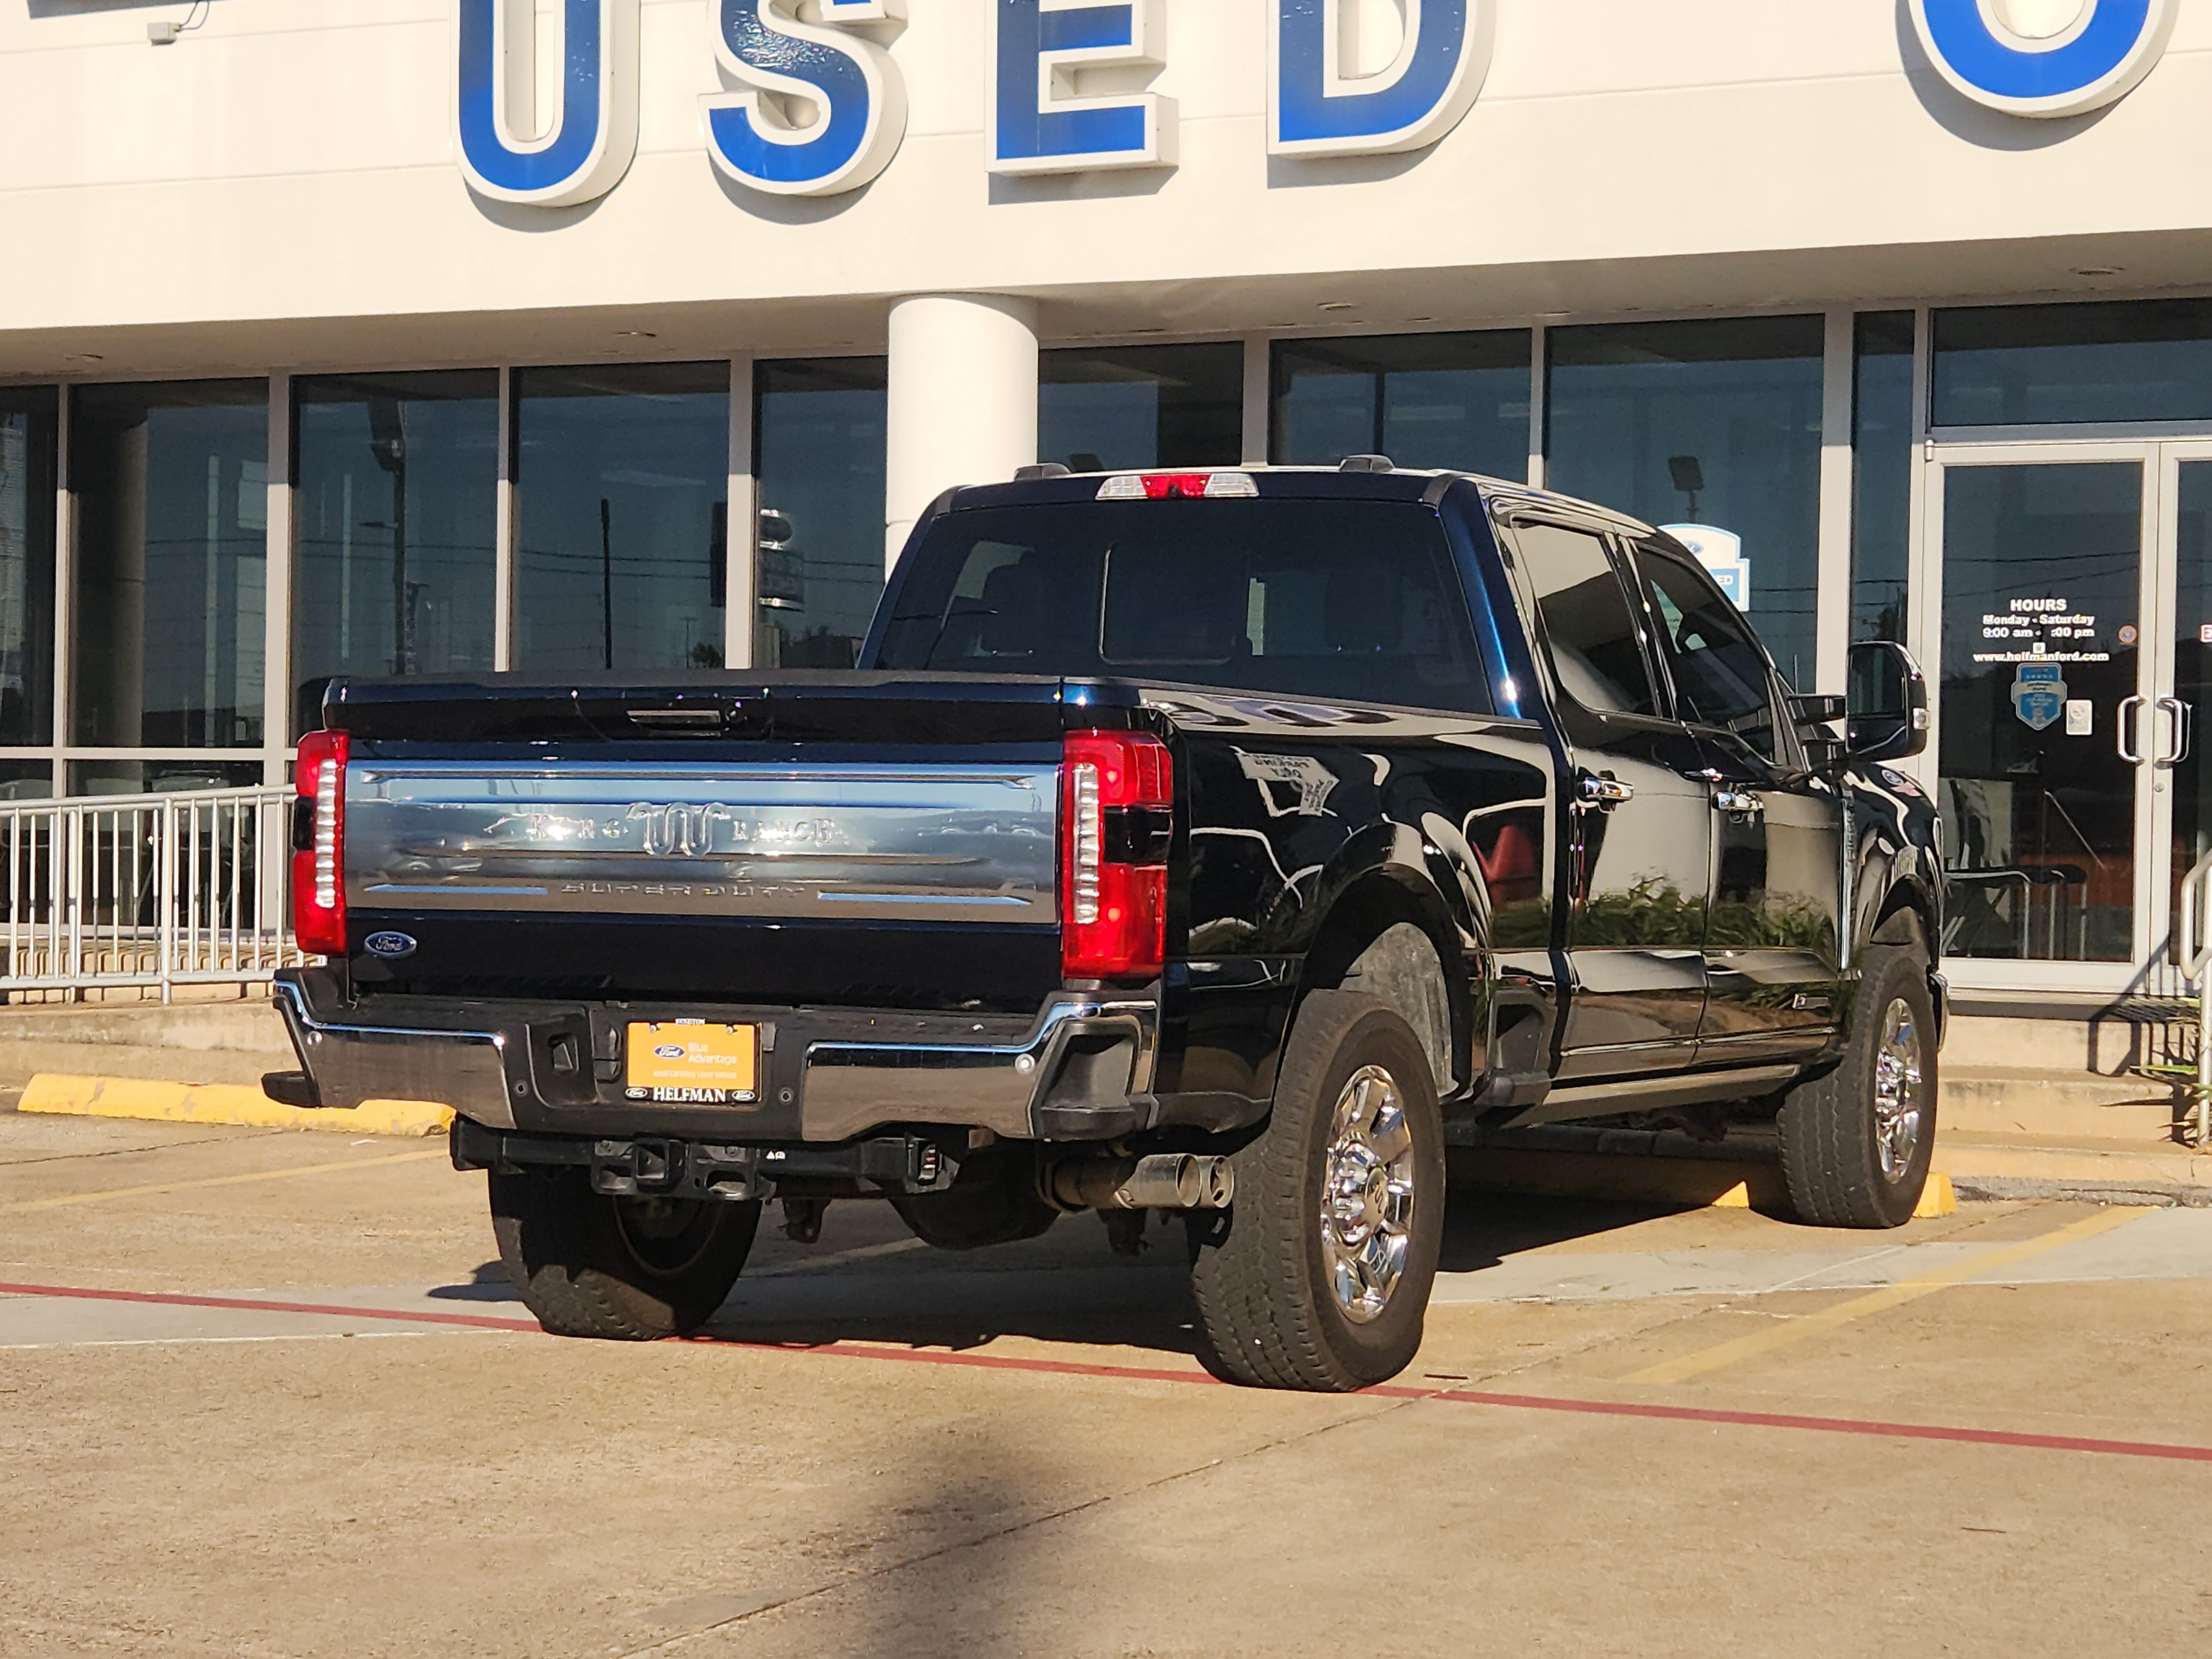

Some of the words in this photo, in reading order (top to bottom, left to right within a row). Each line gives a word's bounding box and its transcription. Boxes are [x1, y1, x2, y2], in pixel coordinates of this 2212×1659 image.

[457, 0, 1477, 200] USED
[2010, 599, 2067, 611] HOURS
[1983, 614, 2030, 626] Monday
[2039, 614, 2095, 626] Saturday
[1983, 627, 2009, 638] 9:00
[2013, 629, 2033, 637] am
[2074, 629, 2095, 639] pm
[1973, 652, 2109, 662] www.helfmanford.com
[688, 1042, 709, 1053] Blue
[688, 1053, 738, 1065] Advantage
[653, 1086, 726, 1102] HELFMAN
